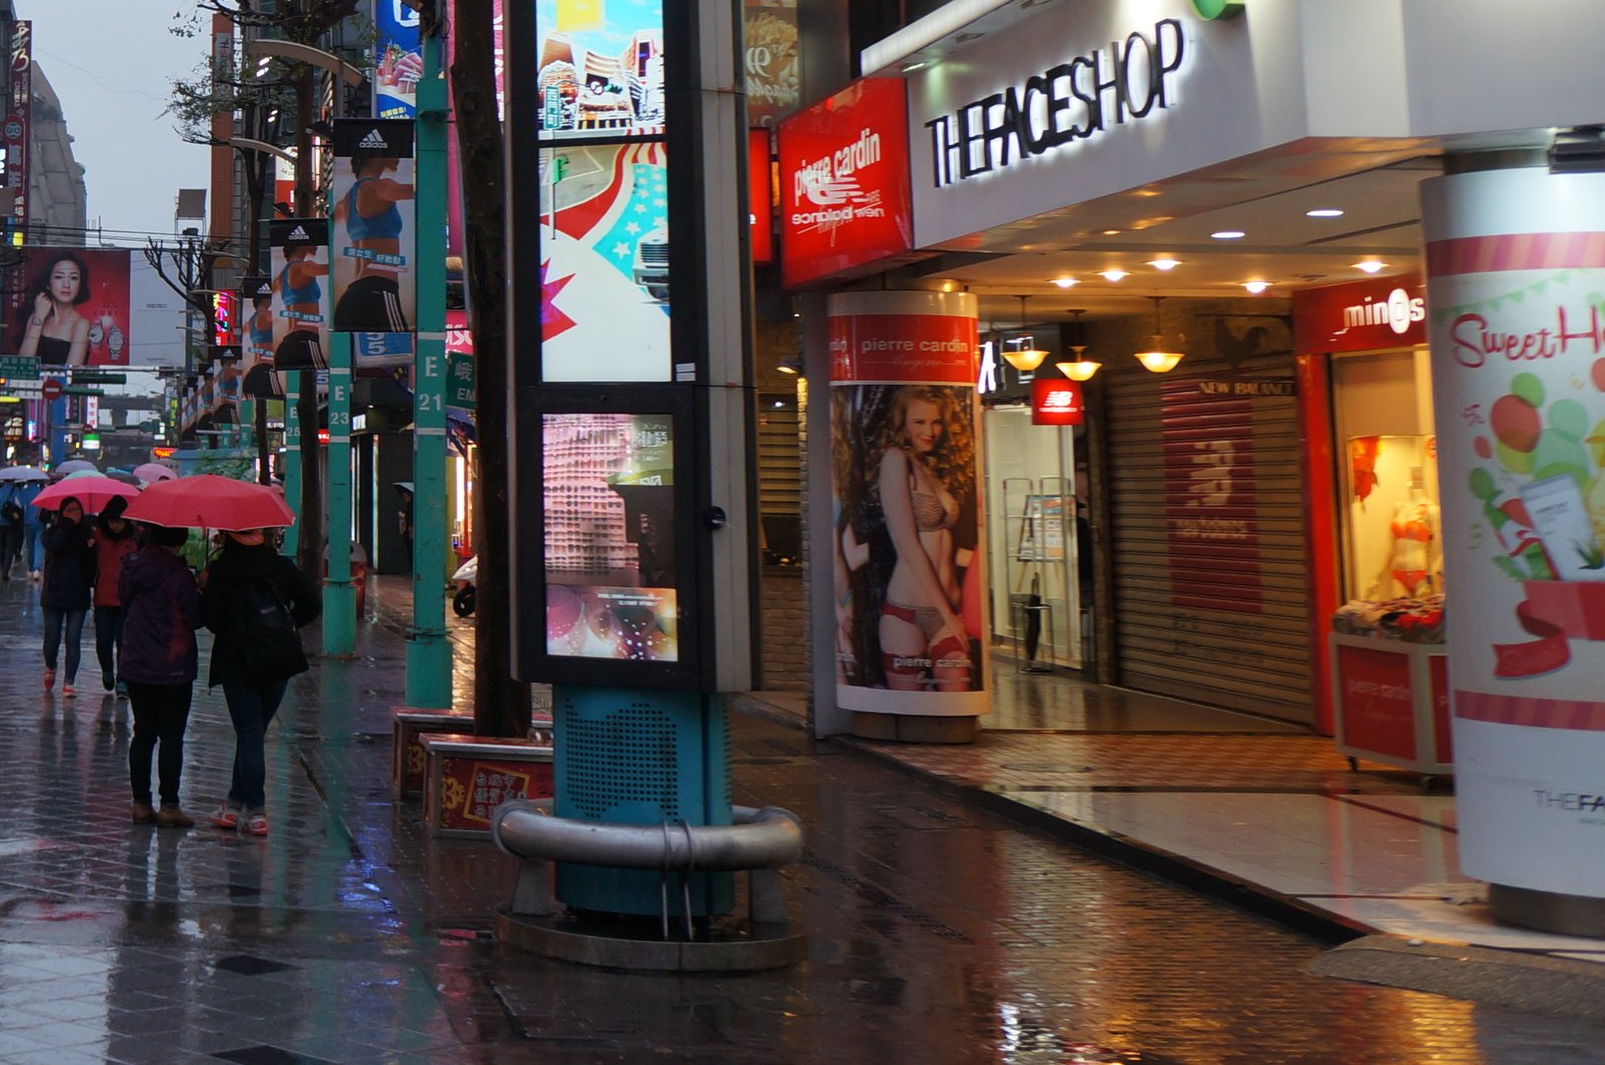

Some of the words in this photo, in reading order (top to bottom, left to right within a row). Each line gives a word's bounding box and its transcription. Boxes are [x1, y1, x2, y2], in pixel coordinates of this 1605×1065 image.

[794, 158, 832, 207] pierre
[834, 127, 881, 179] cardin
[861, 338, 914, 354] pierre
[919, 337, 969, 353] cardin
[1449, 312, 1557, 370] Sweet
[425, 356, 438, 377] E
[334, 385, 345, 401] E
[418, 393, 442, 411] 21
[330, 411, 349, 425] 23
